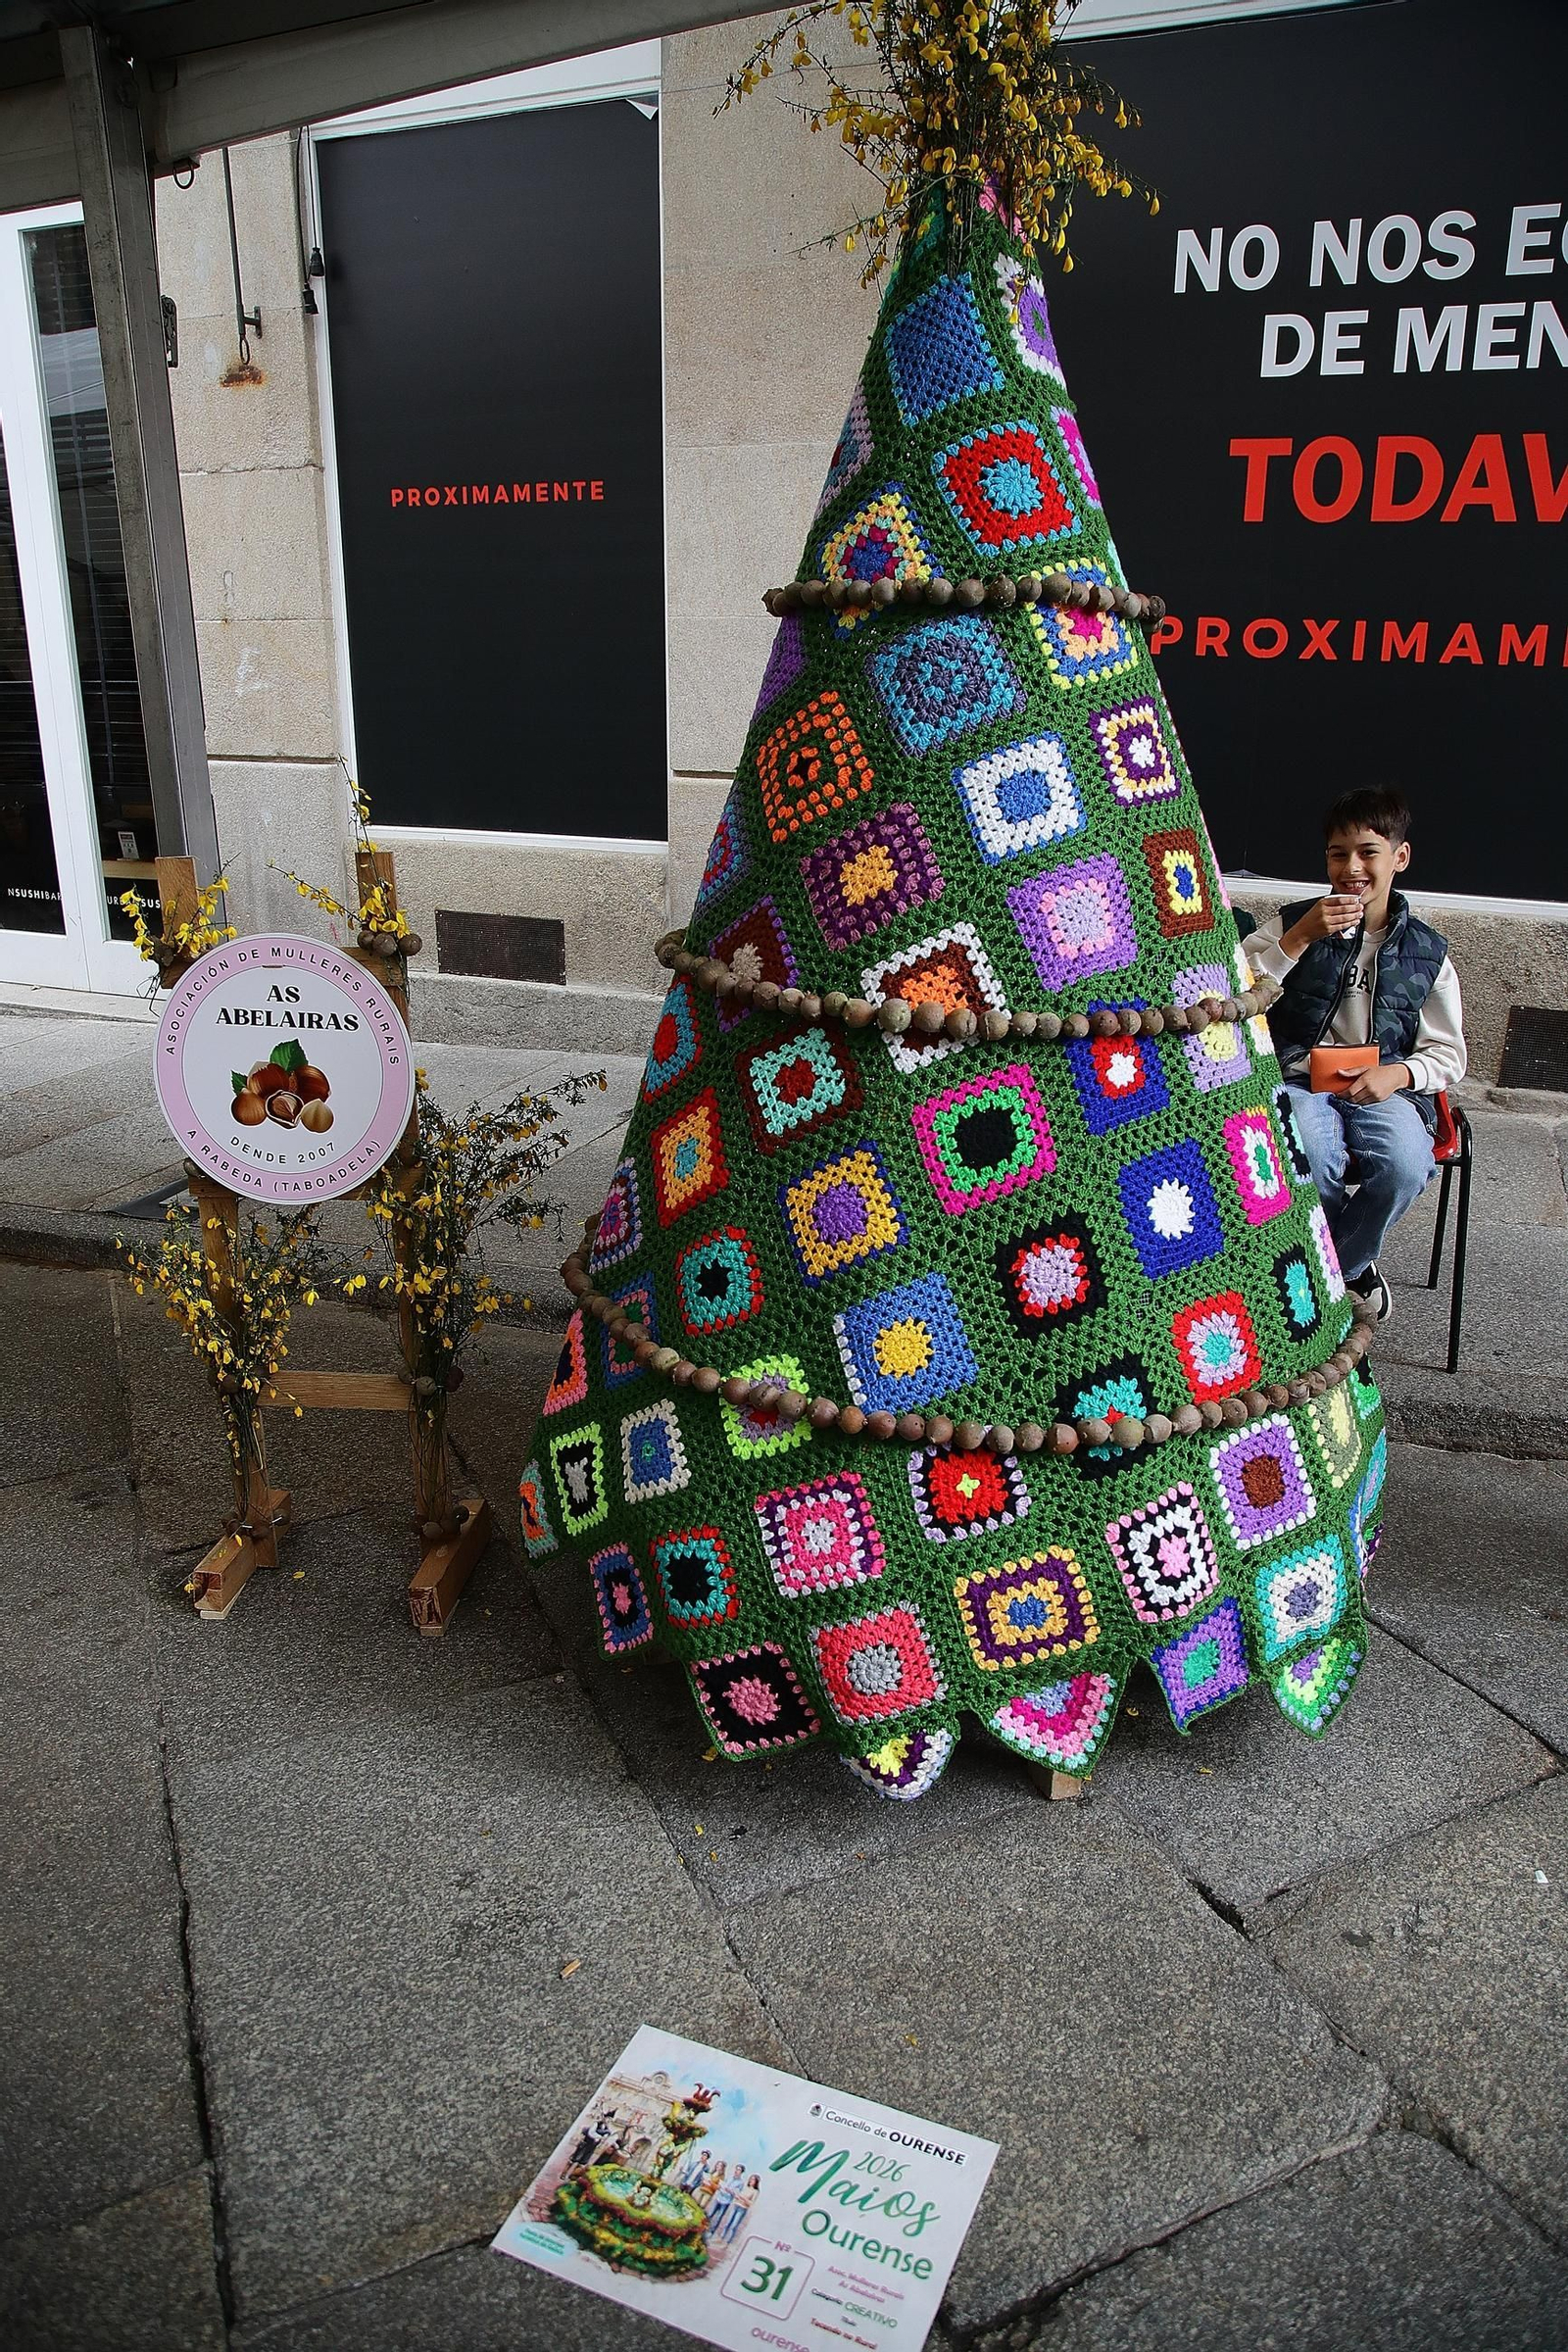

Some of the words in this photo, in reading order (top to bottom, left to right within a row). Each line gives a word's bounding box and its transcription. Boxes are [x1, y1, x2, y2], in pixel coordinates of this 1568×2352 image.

[1174, 223, 1280, 293] NO
[1309, 210, 1477, 287] NOS
[1504, 203, 1568, 276] E
[1260, 310, 1369, 377] DE
[1393, 300, 1568, 373] MEN
[391, 480, 605, 508] PROXIMAMENTE
[1229, 433, 1568, 522] TODAV
[1150, 615, 1568, 668] PROXIMAM
[166, 958, 230, 1055] ASOCIACIÓN
[238, 949, 260, 962] DE
[270, 947, 362, 992] MULLERES
[366, 997, 400, 1066] RURAIS
[216, 1007, 360, 1032] ABELAIRAS
[267, 984, 301, 1004] AS
[187, 1129, 197, 1139] A
[201, 1145, 263, 1188] RABEDA
[273, 1139, 381, 1193] (TABOADELA)
[230, 1136, 287, 1164] DENDE
[298, 1142, 335, 1164] 2007
[825, 2110, 871, 2132] Concello
[874, 2127, 887, 2138] de
[889, 2132, 966, 2165] OURENSE
[768, 2139, 941, 2237] Maios
[854, 2151, 911, 2182] 2026
[802, 2209, 933, 2279] Ourense
[740, 2255, 794, 2301] 31
[845, 2301, 899, 2328] CREATIVO
